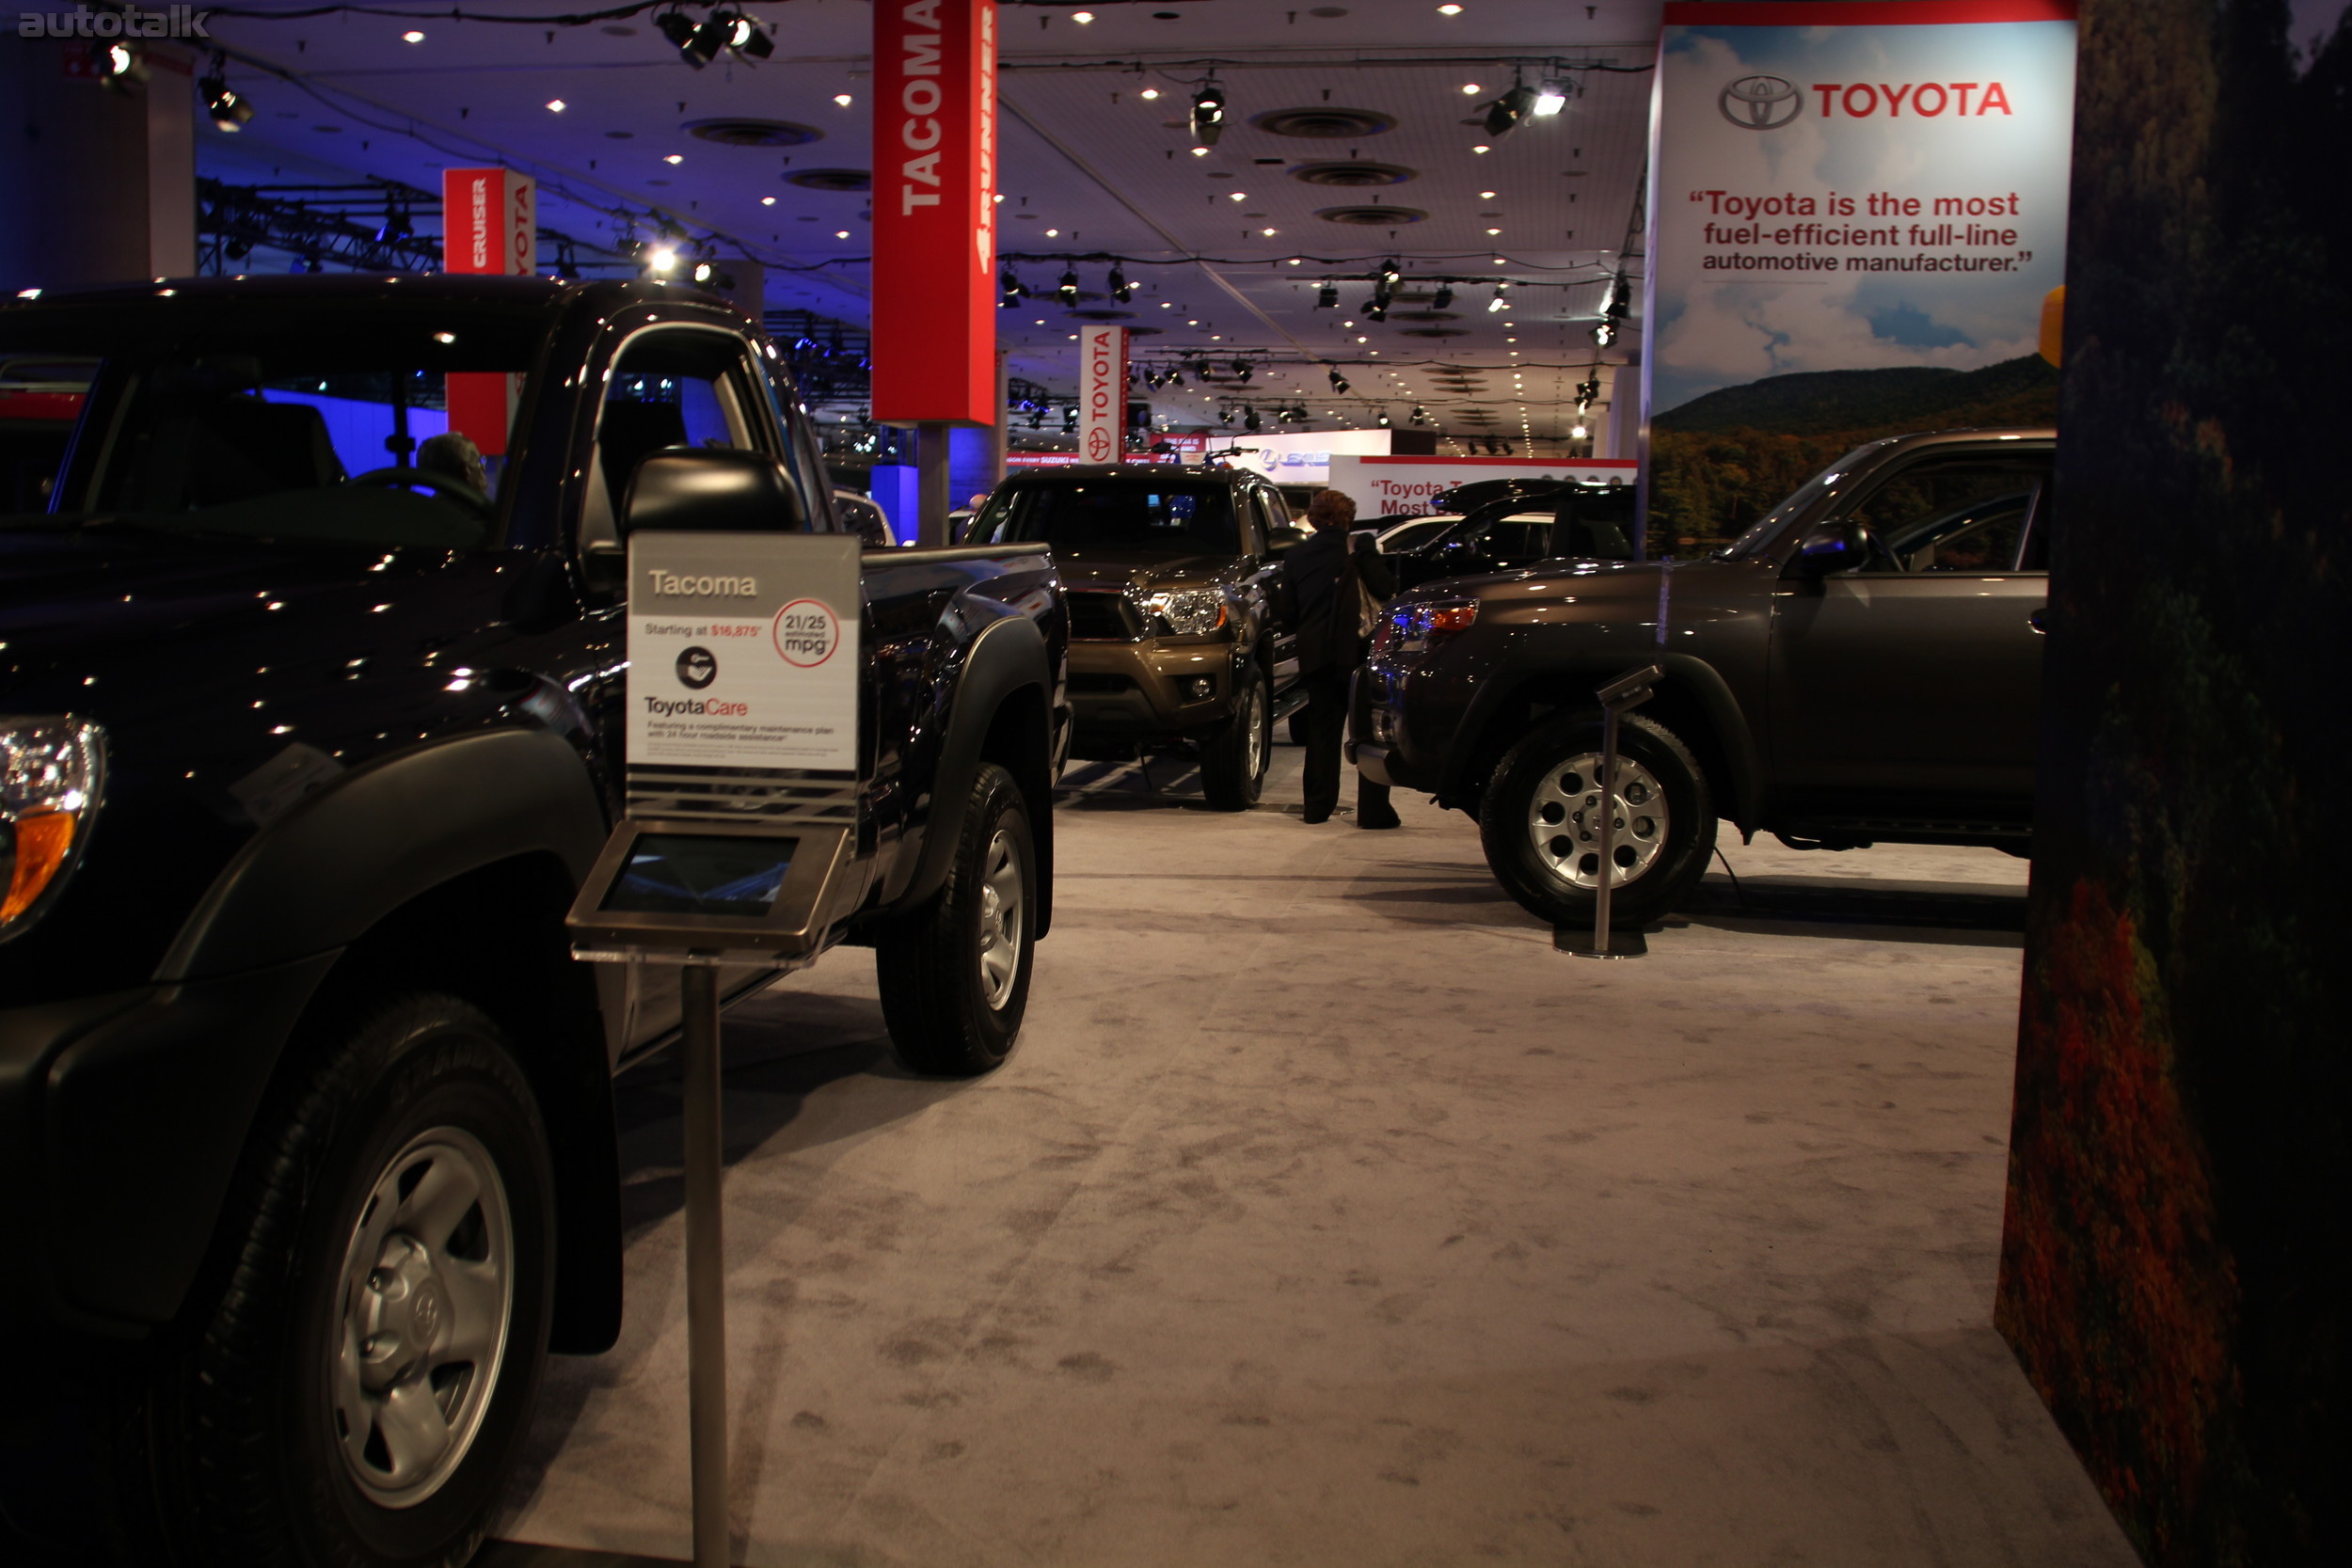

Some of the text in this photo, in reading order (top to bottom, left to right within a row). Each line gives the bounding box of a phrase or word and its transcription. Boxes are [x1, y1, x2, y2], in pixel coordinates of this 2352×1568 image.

[902, 0, 942, 215] TACOMA
[1813, 82, 2012, 119] TOYOTA
[977, 6, 993, 275] 4RUNNER
[1690, 190, 2020, 221] “Toyota is the most
[472, 177, 487, 268] CRUISER
[515, 184, 529, 276] YOTA
[1704, 222, 2018, 246] fuel-efficient full-line
[1703, 250, 2033, 273] automotive manufacturer.”
[1092, 331, 1110, 421] TOYOTA
[1381, 499, 1429, 515] Most
[647, 569, 757, 596] Tacoma
[644, 623, 692, 638] Starting
[696, 626, 707, 636] at
[786, 614, 826, 631] 21/25
[644, 697, 748, 717] ToyotaCare
[759, 725, 814, 734] maintenance
